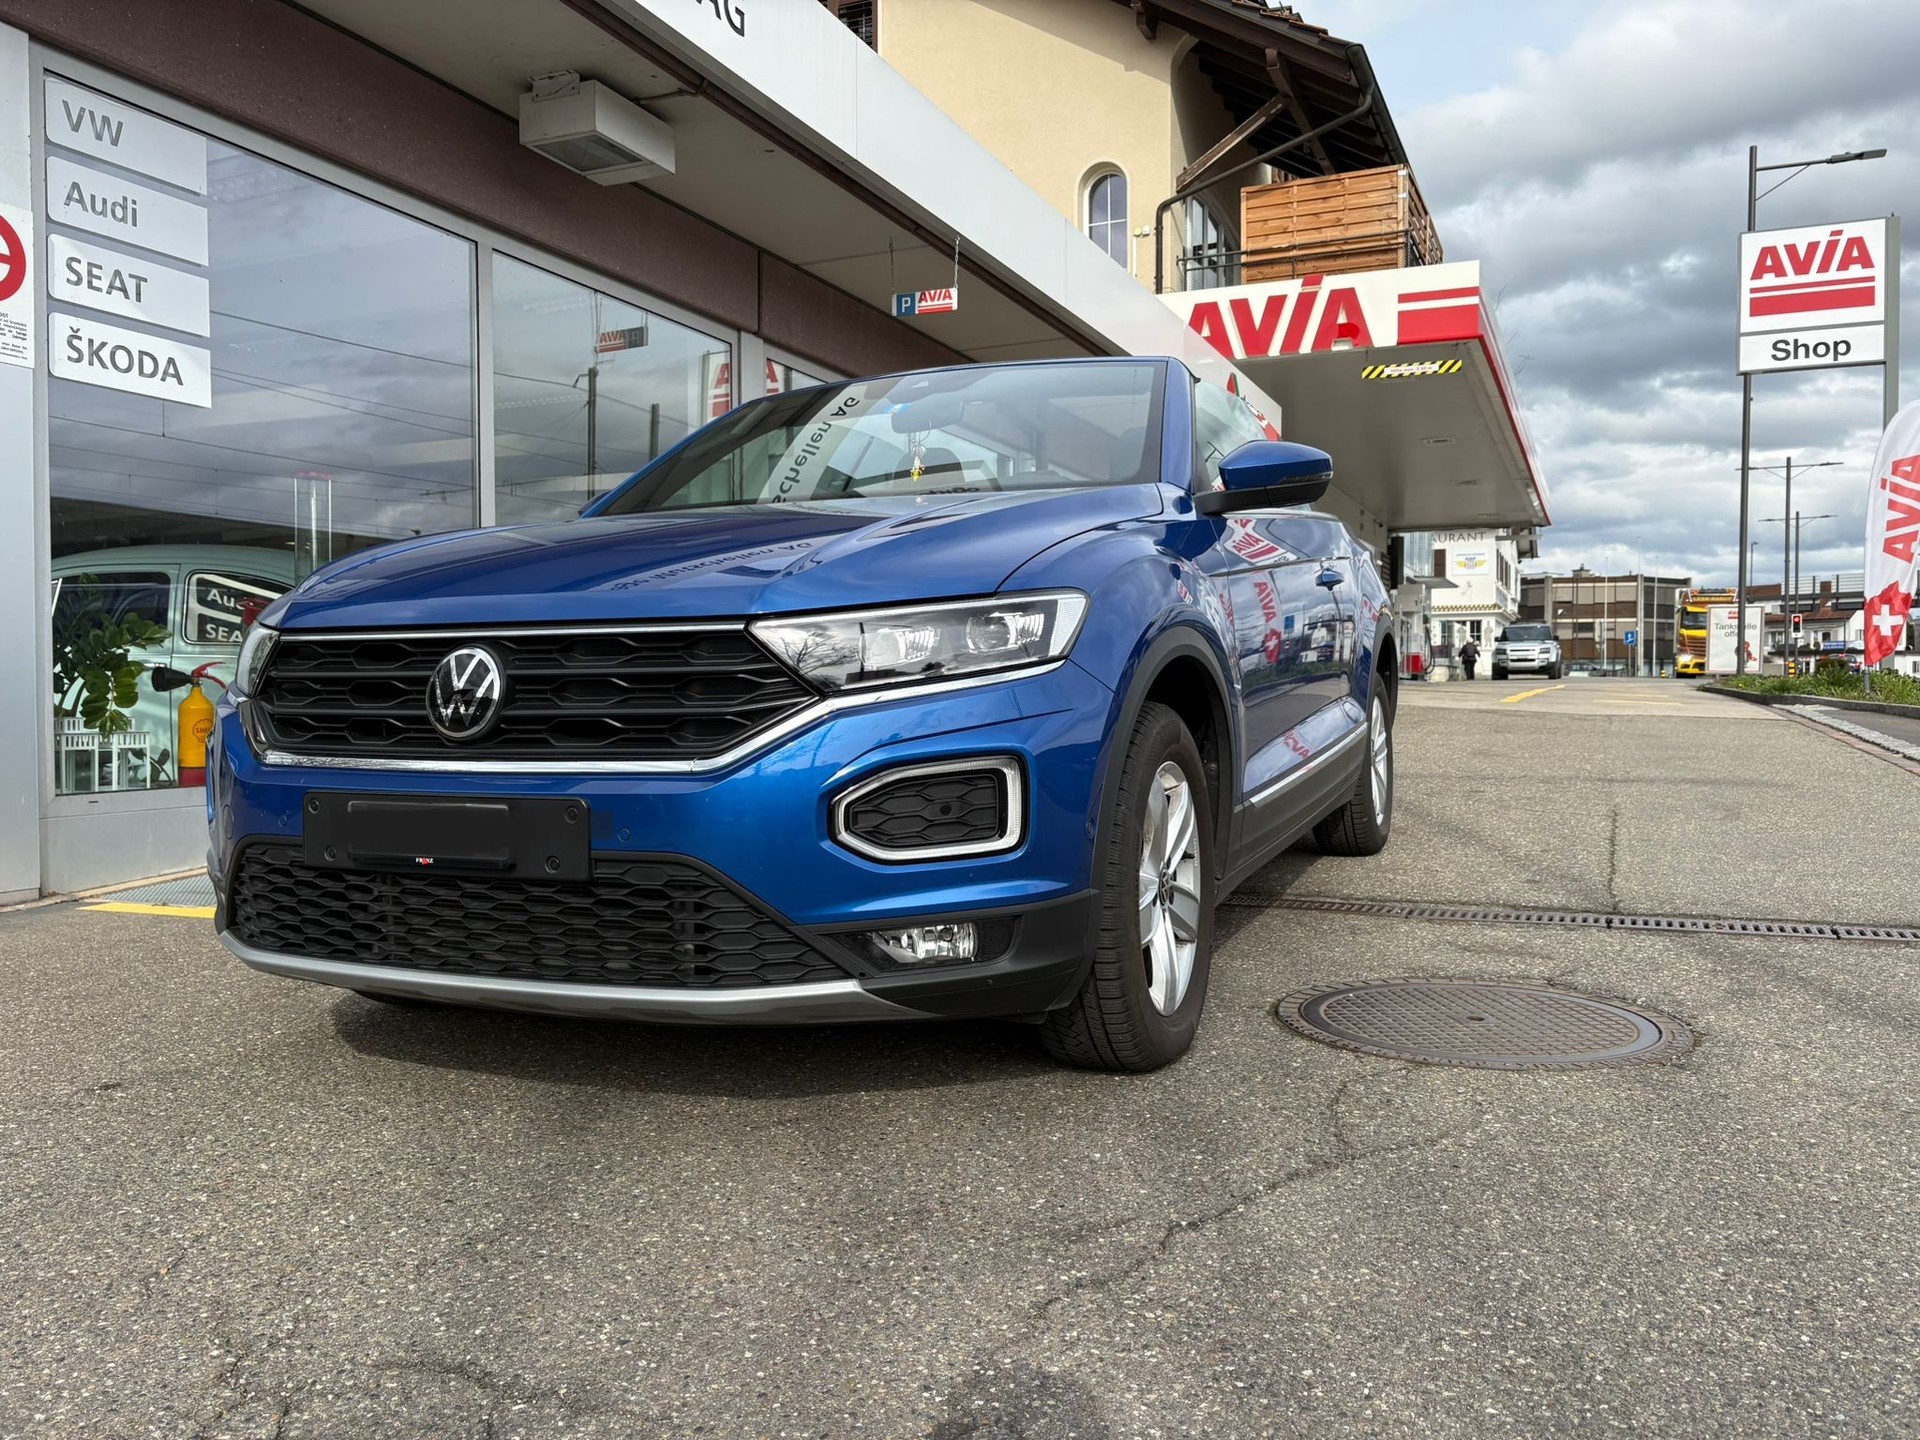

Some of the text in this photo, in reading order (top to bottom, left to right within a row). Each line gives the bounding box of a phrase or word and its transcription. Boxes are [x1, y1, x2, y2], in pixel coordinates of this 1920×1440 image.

[62, 99, 124, 147] VW
[63, 181, 138, 228] Audi
[1749, 229, 1876, 281] AVIA
[65, 256, 148, 303] SEAT
[901, 288, 953, 313] P AVIA
[1188, 274, 1375, 359] AVIA
[66, 326, 184, 386] ŠKODA
[1770, 338, 1852, 362] Shop
[1882, 455, 1920, 565] AVIA
[205, 624, 244, 643] SEA
